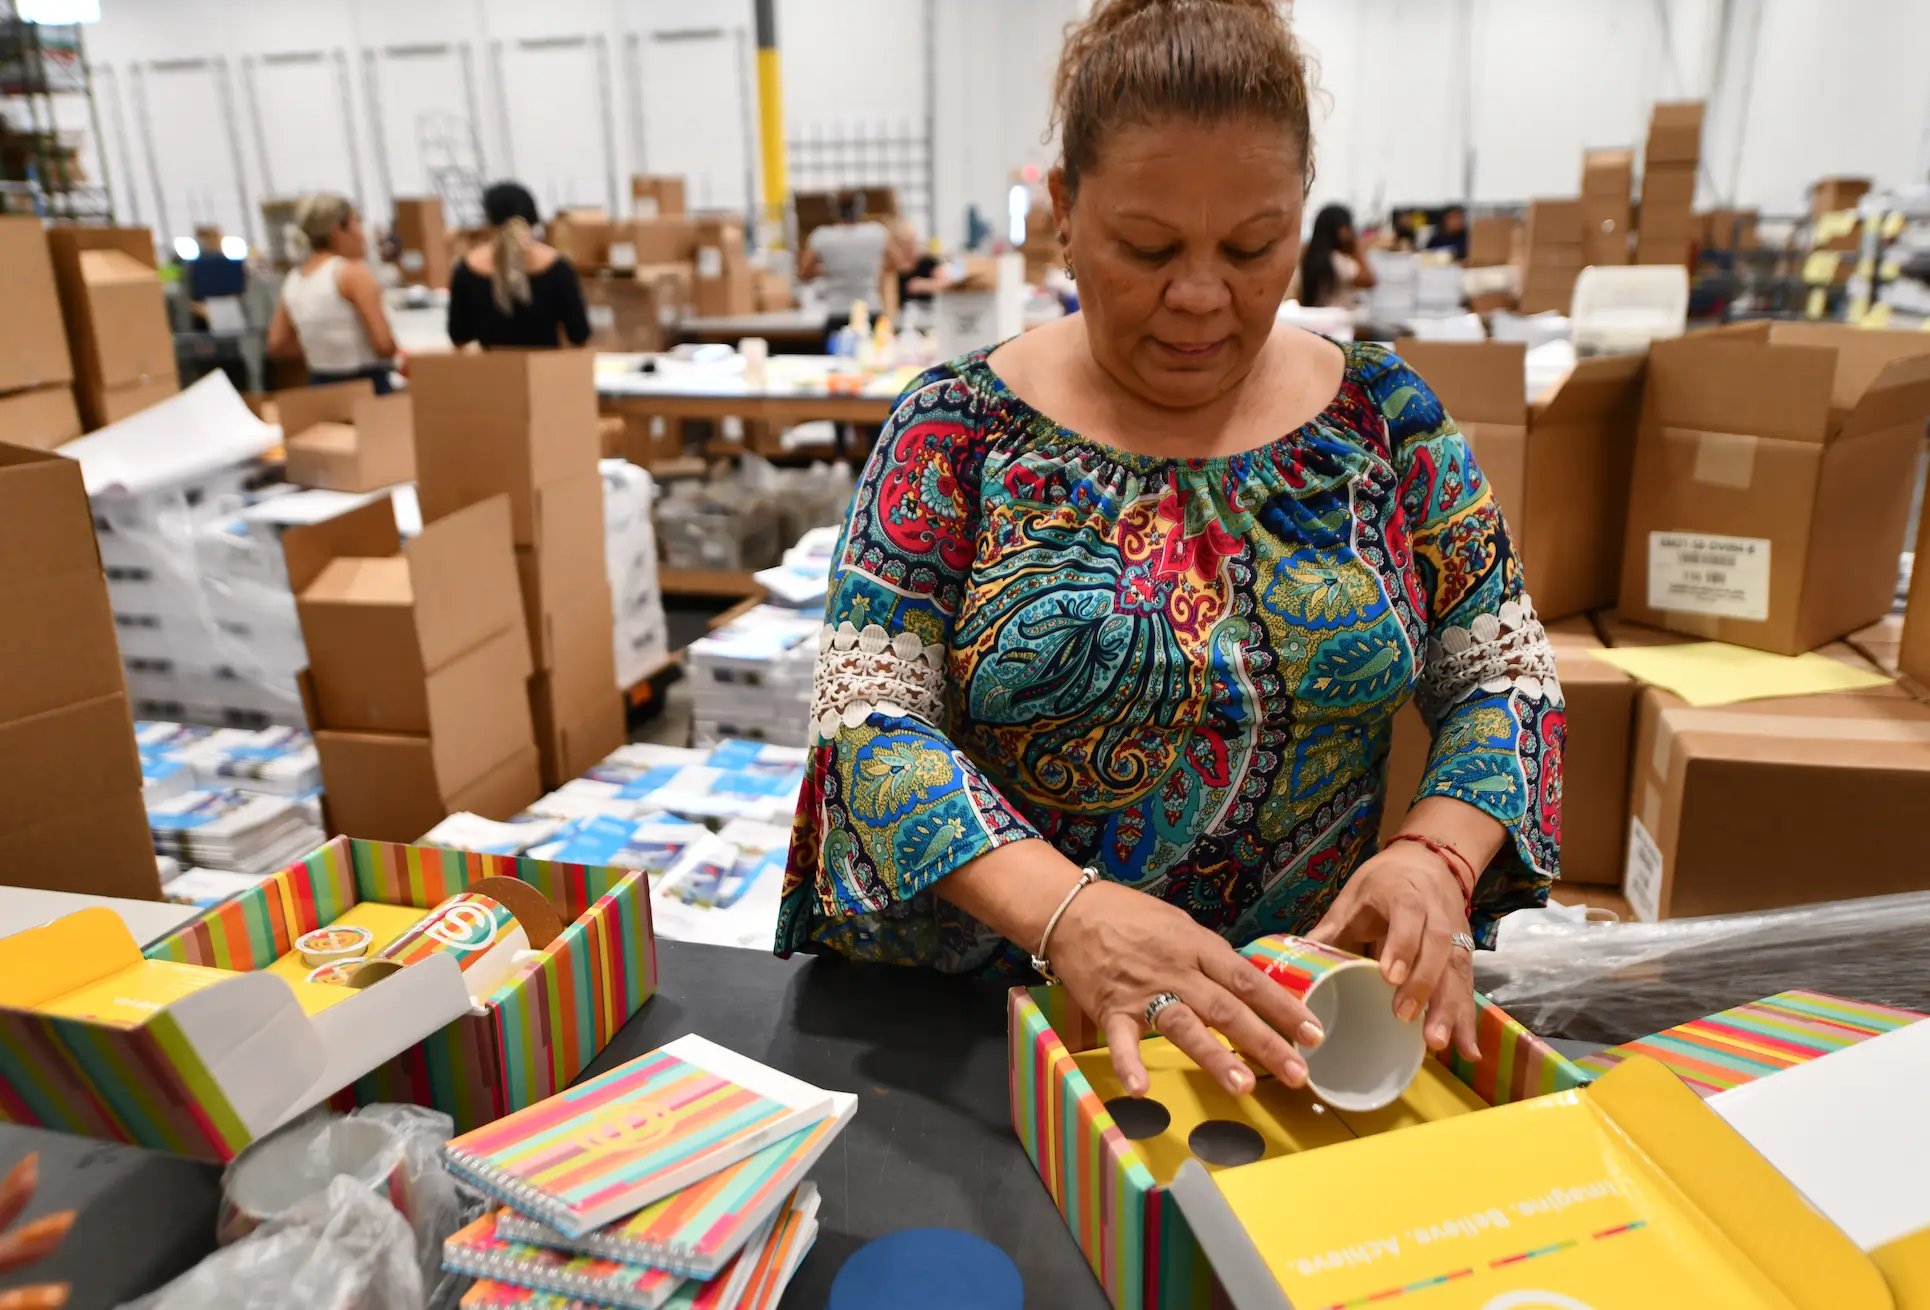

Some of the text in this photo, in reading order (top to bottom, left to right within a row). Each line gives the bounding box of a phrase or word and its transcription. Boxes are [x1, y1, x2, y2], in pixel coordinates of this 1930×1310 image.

[1287, 1179, 1619, 1276] Imagine. Believe. Achieve.
